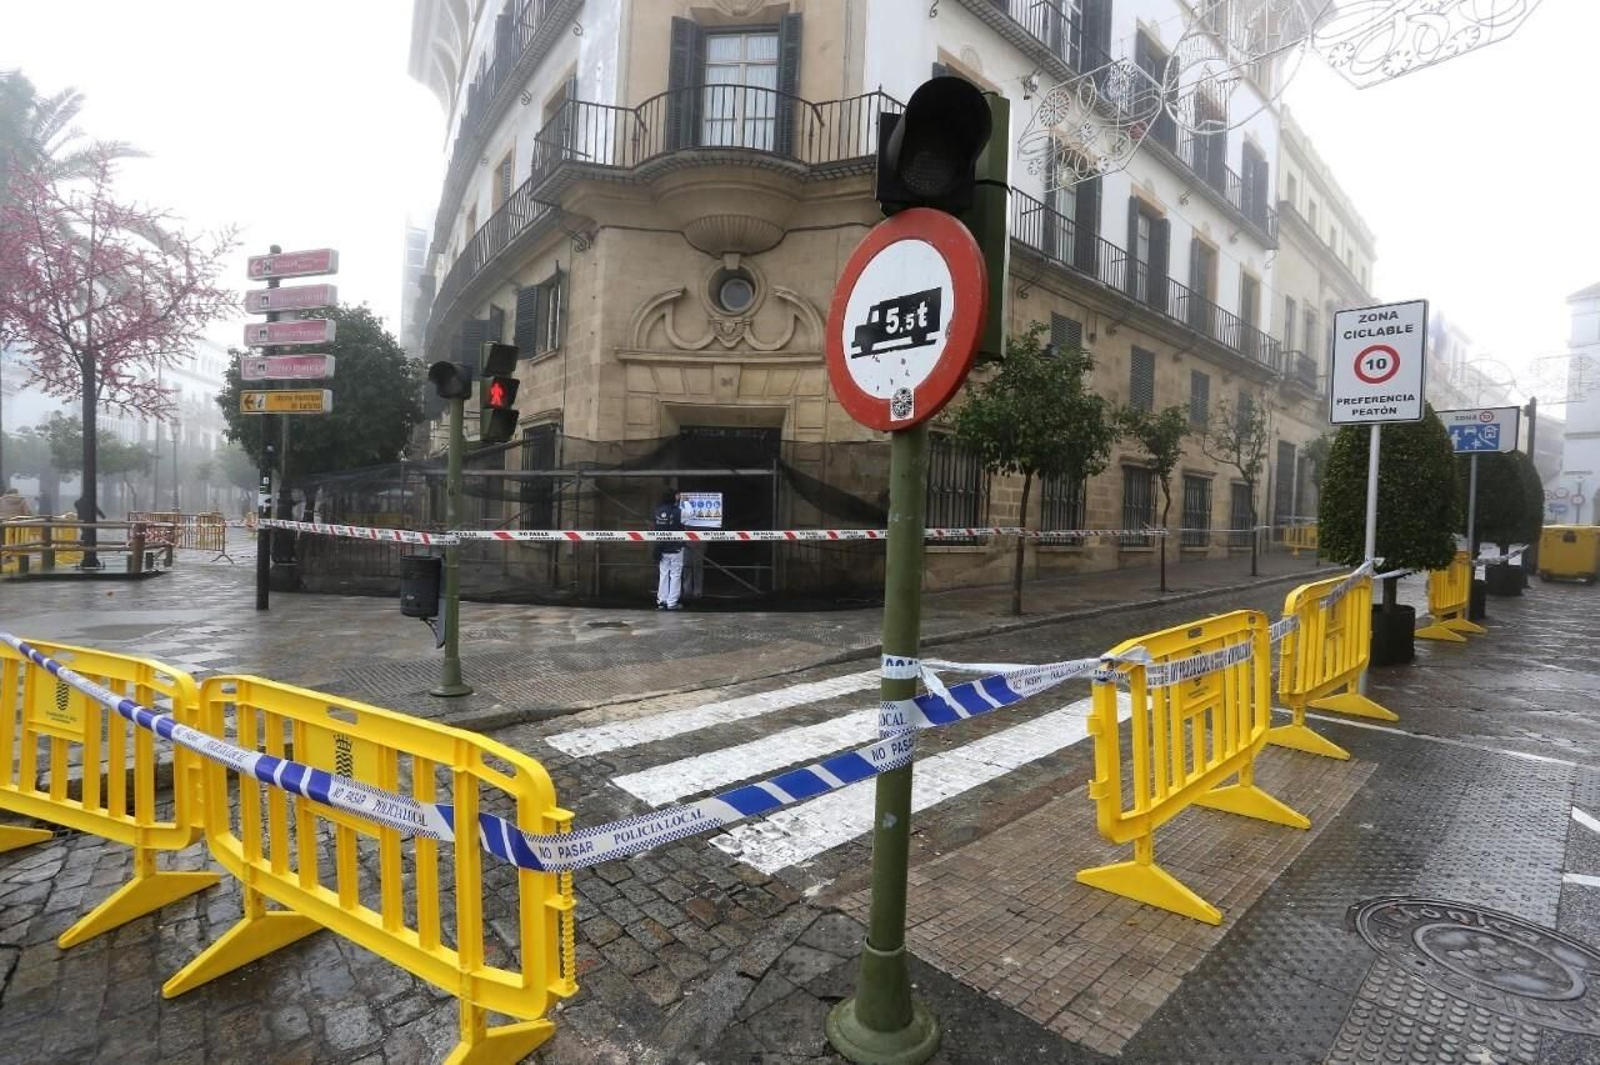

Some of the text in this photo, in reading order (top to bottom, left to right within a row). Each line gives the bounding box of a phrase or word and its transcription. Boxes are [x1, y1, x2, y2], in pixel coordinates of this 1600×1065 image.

[1358, 311, 1398, 323] ZONA
[1343, 324, 1414, 340] CICLABLE
[1365, 357, 1388, 371] 10
[1336, 394, 1415, 405] PREFERENCIA
[1351, 405, 1398, 417] PEATÓN
[879, 712, 907, 727] OCAL
[871, 747, 886, 762] NO
[538, 845, 552, 859] NO
[558, 841, 594, 859] PASAR
